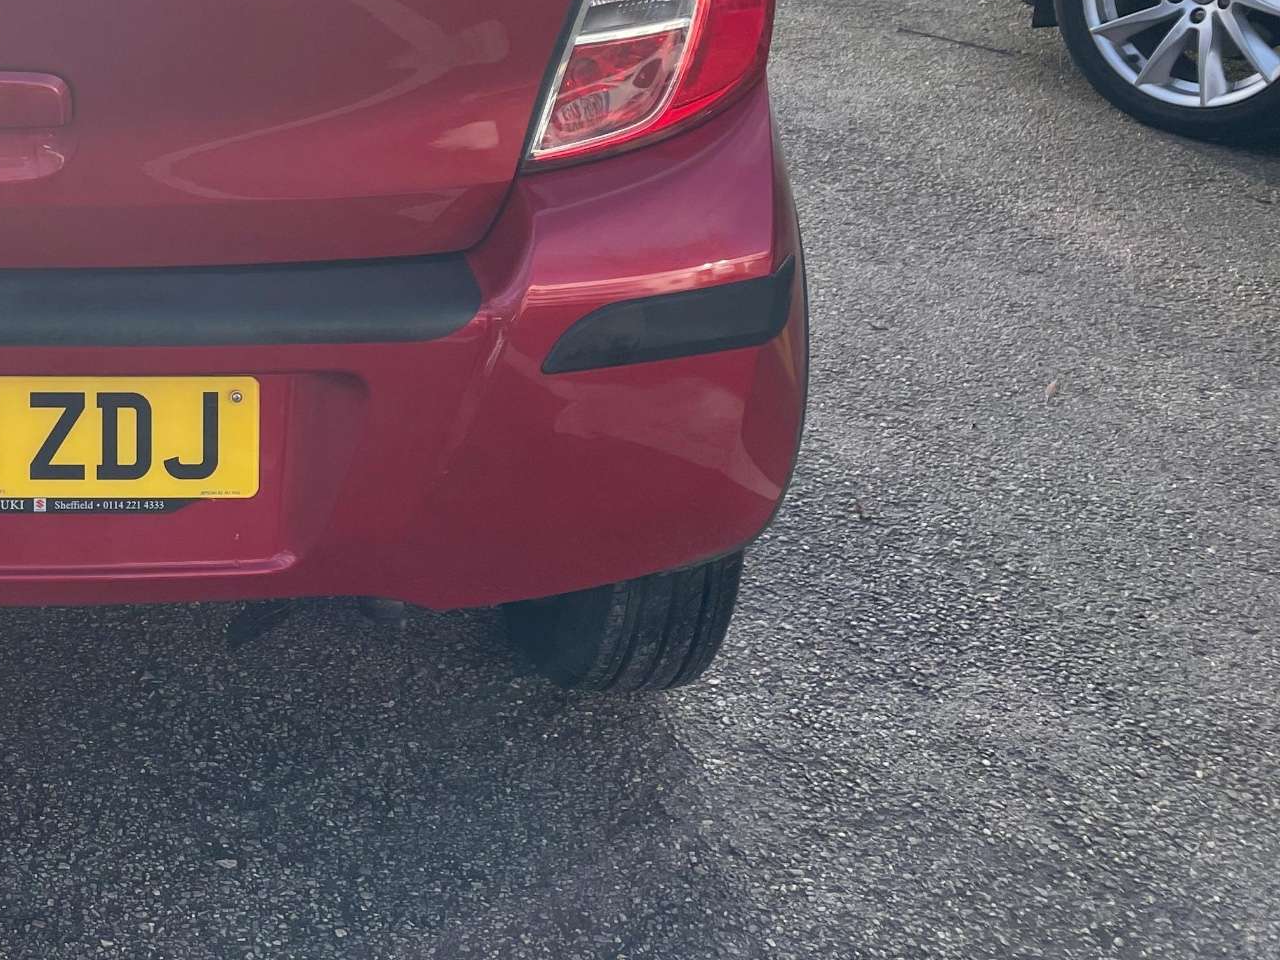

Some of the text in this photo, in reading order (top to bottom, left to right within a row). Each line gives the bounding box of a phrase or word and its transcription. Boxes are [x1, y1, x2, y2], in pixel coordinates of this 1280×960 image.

[29, 391, 220, 481] ZDJ
[54, 500, 94, 511] Sheffield
[103, 501, 124, 511] 0114
[126, 501, 142, 511] 221
[143, 501, 164, 511] 4333
